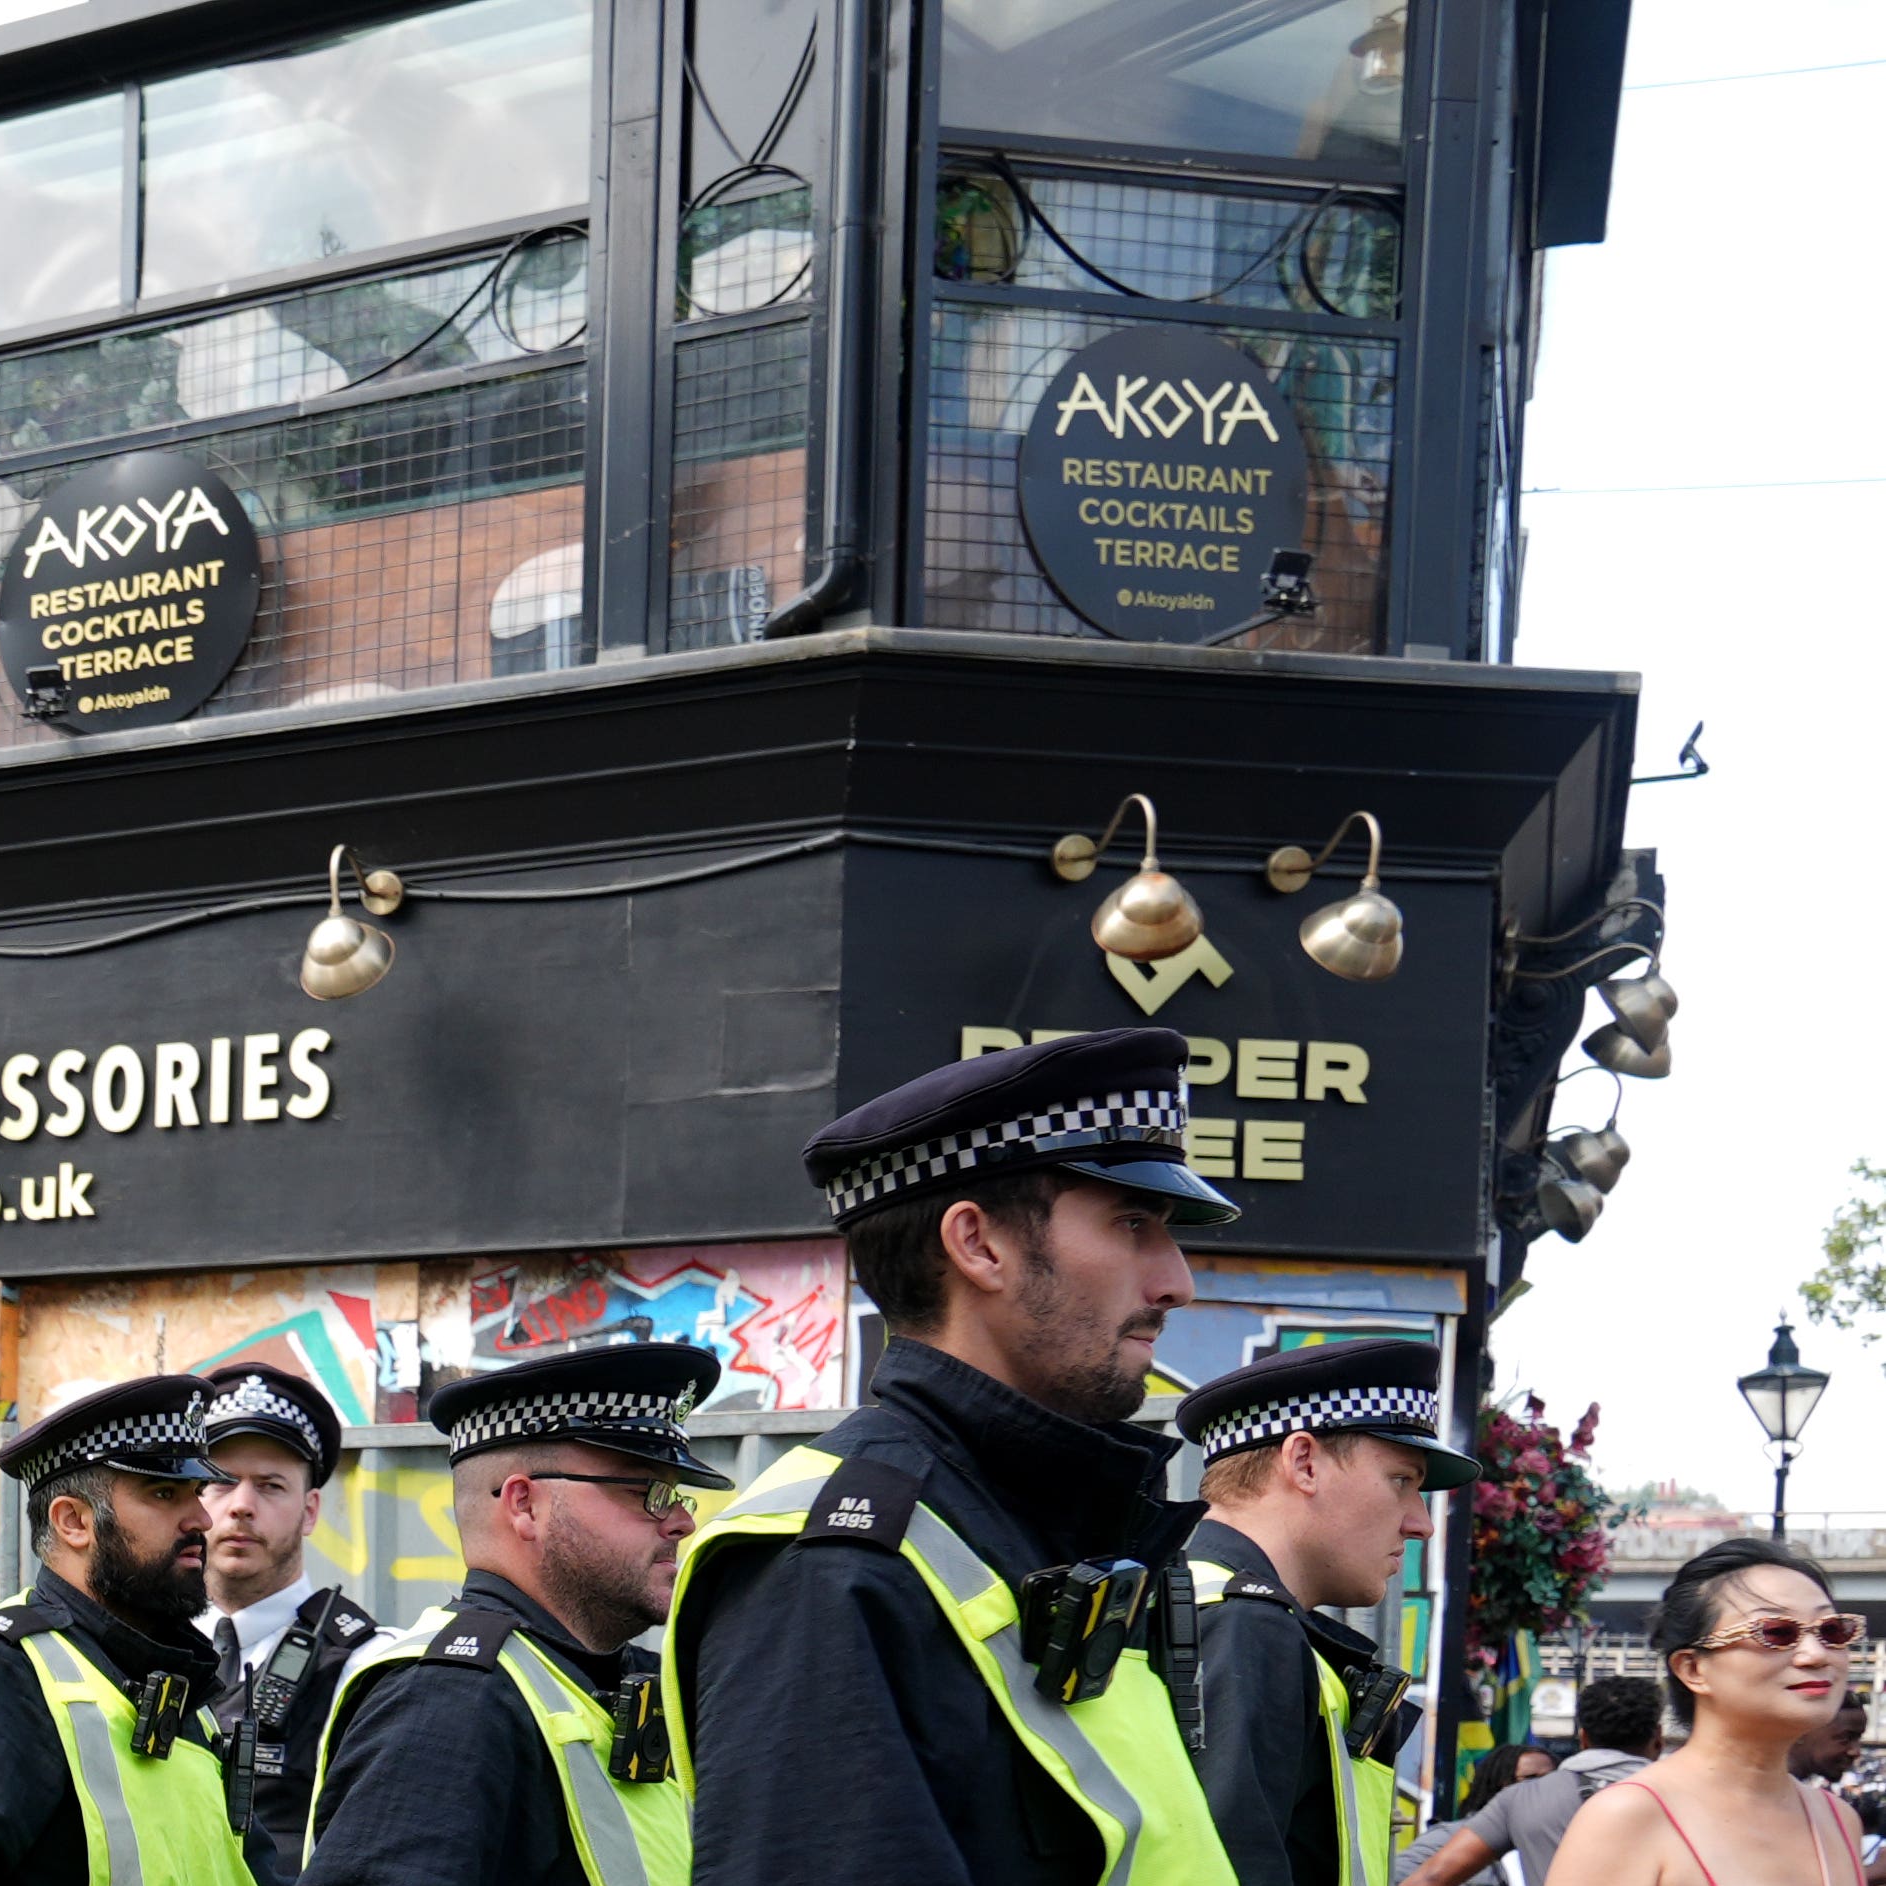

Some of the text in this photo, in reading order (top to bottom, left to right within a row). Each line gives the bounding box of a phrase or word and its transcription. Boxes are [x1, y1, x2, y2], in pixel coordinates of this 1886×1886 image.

[1055, 372, 1280, 445] AKOYA
[1062, 457, 1273, 497] RESTAURANT
[22, 485, 230, 579] AKOYA
[1078, 498, 1255, 536] COCKTAILS
[1093, 537, 1241, 573] TERRACE
[29, 558, 226, 620] RESTAURANT
[41, 598, 206, 651] COCKTAILS
[57, 636, 195, 682] TERRACE
[1185, 1117, 1306, 1182] EE
[827, 1511, 876, 1530] 1395
[838, 1496, 871, 1512] NA
[453, 1636, 478, 1646] NA
